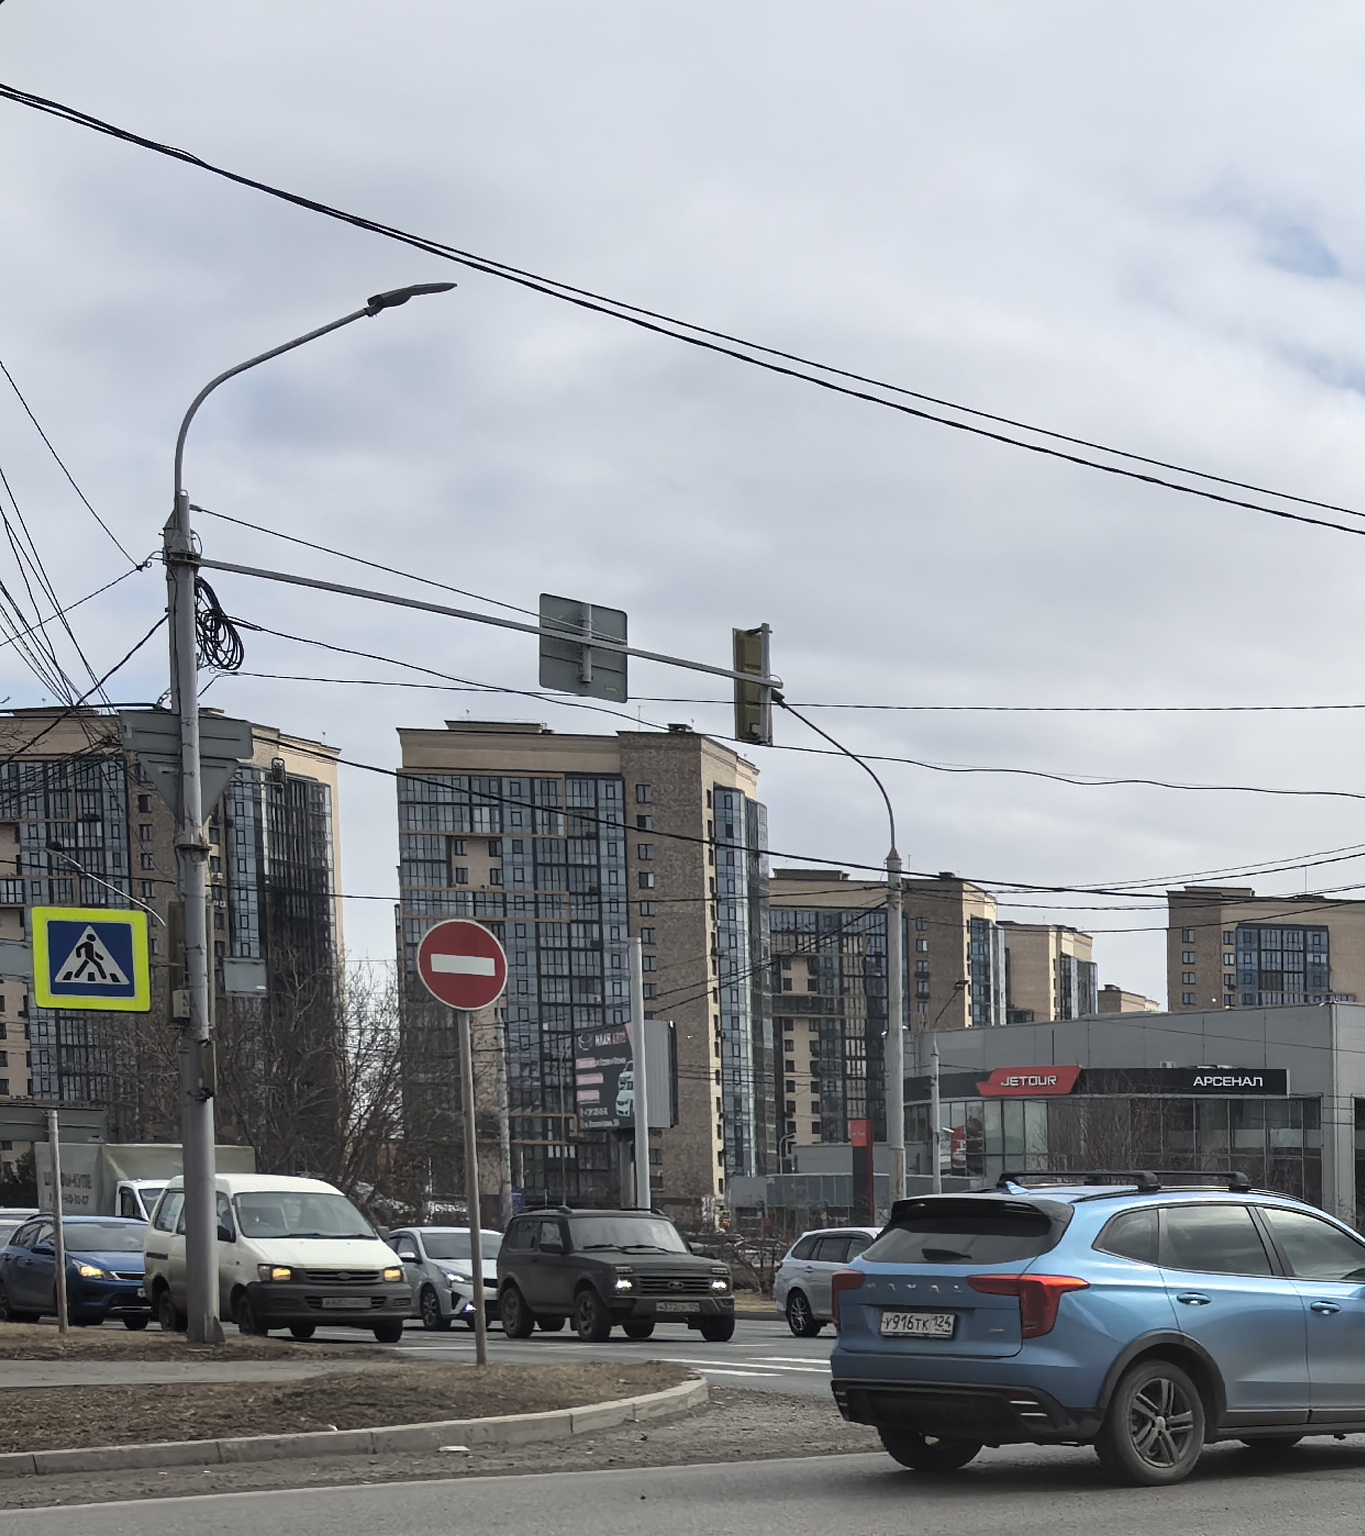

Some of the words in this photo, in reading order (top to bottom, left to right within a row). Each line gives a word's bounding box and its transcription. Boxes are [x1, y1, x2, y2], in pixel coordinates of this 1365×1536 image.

[1000, 1075, 1057, 1087] JETOUR
[1193, 1076, 1263, 1088] АРСЕНАЛ
[884, 1315, 930, 1330] У916ТК
[933, 1315, 951, 1328] 124
